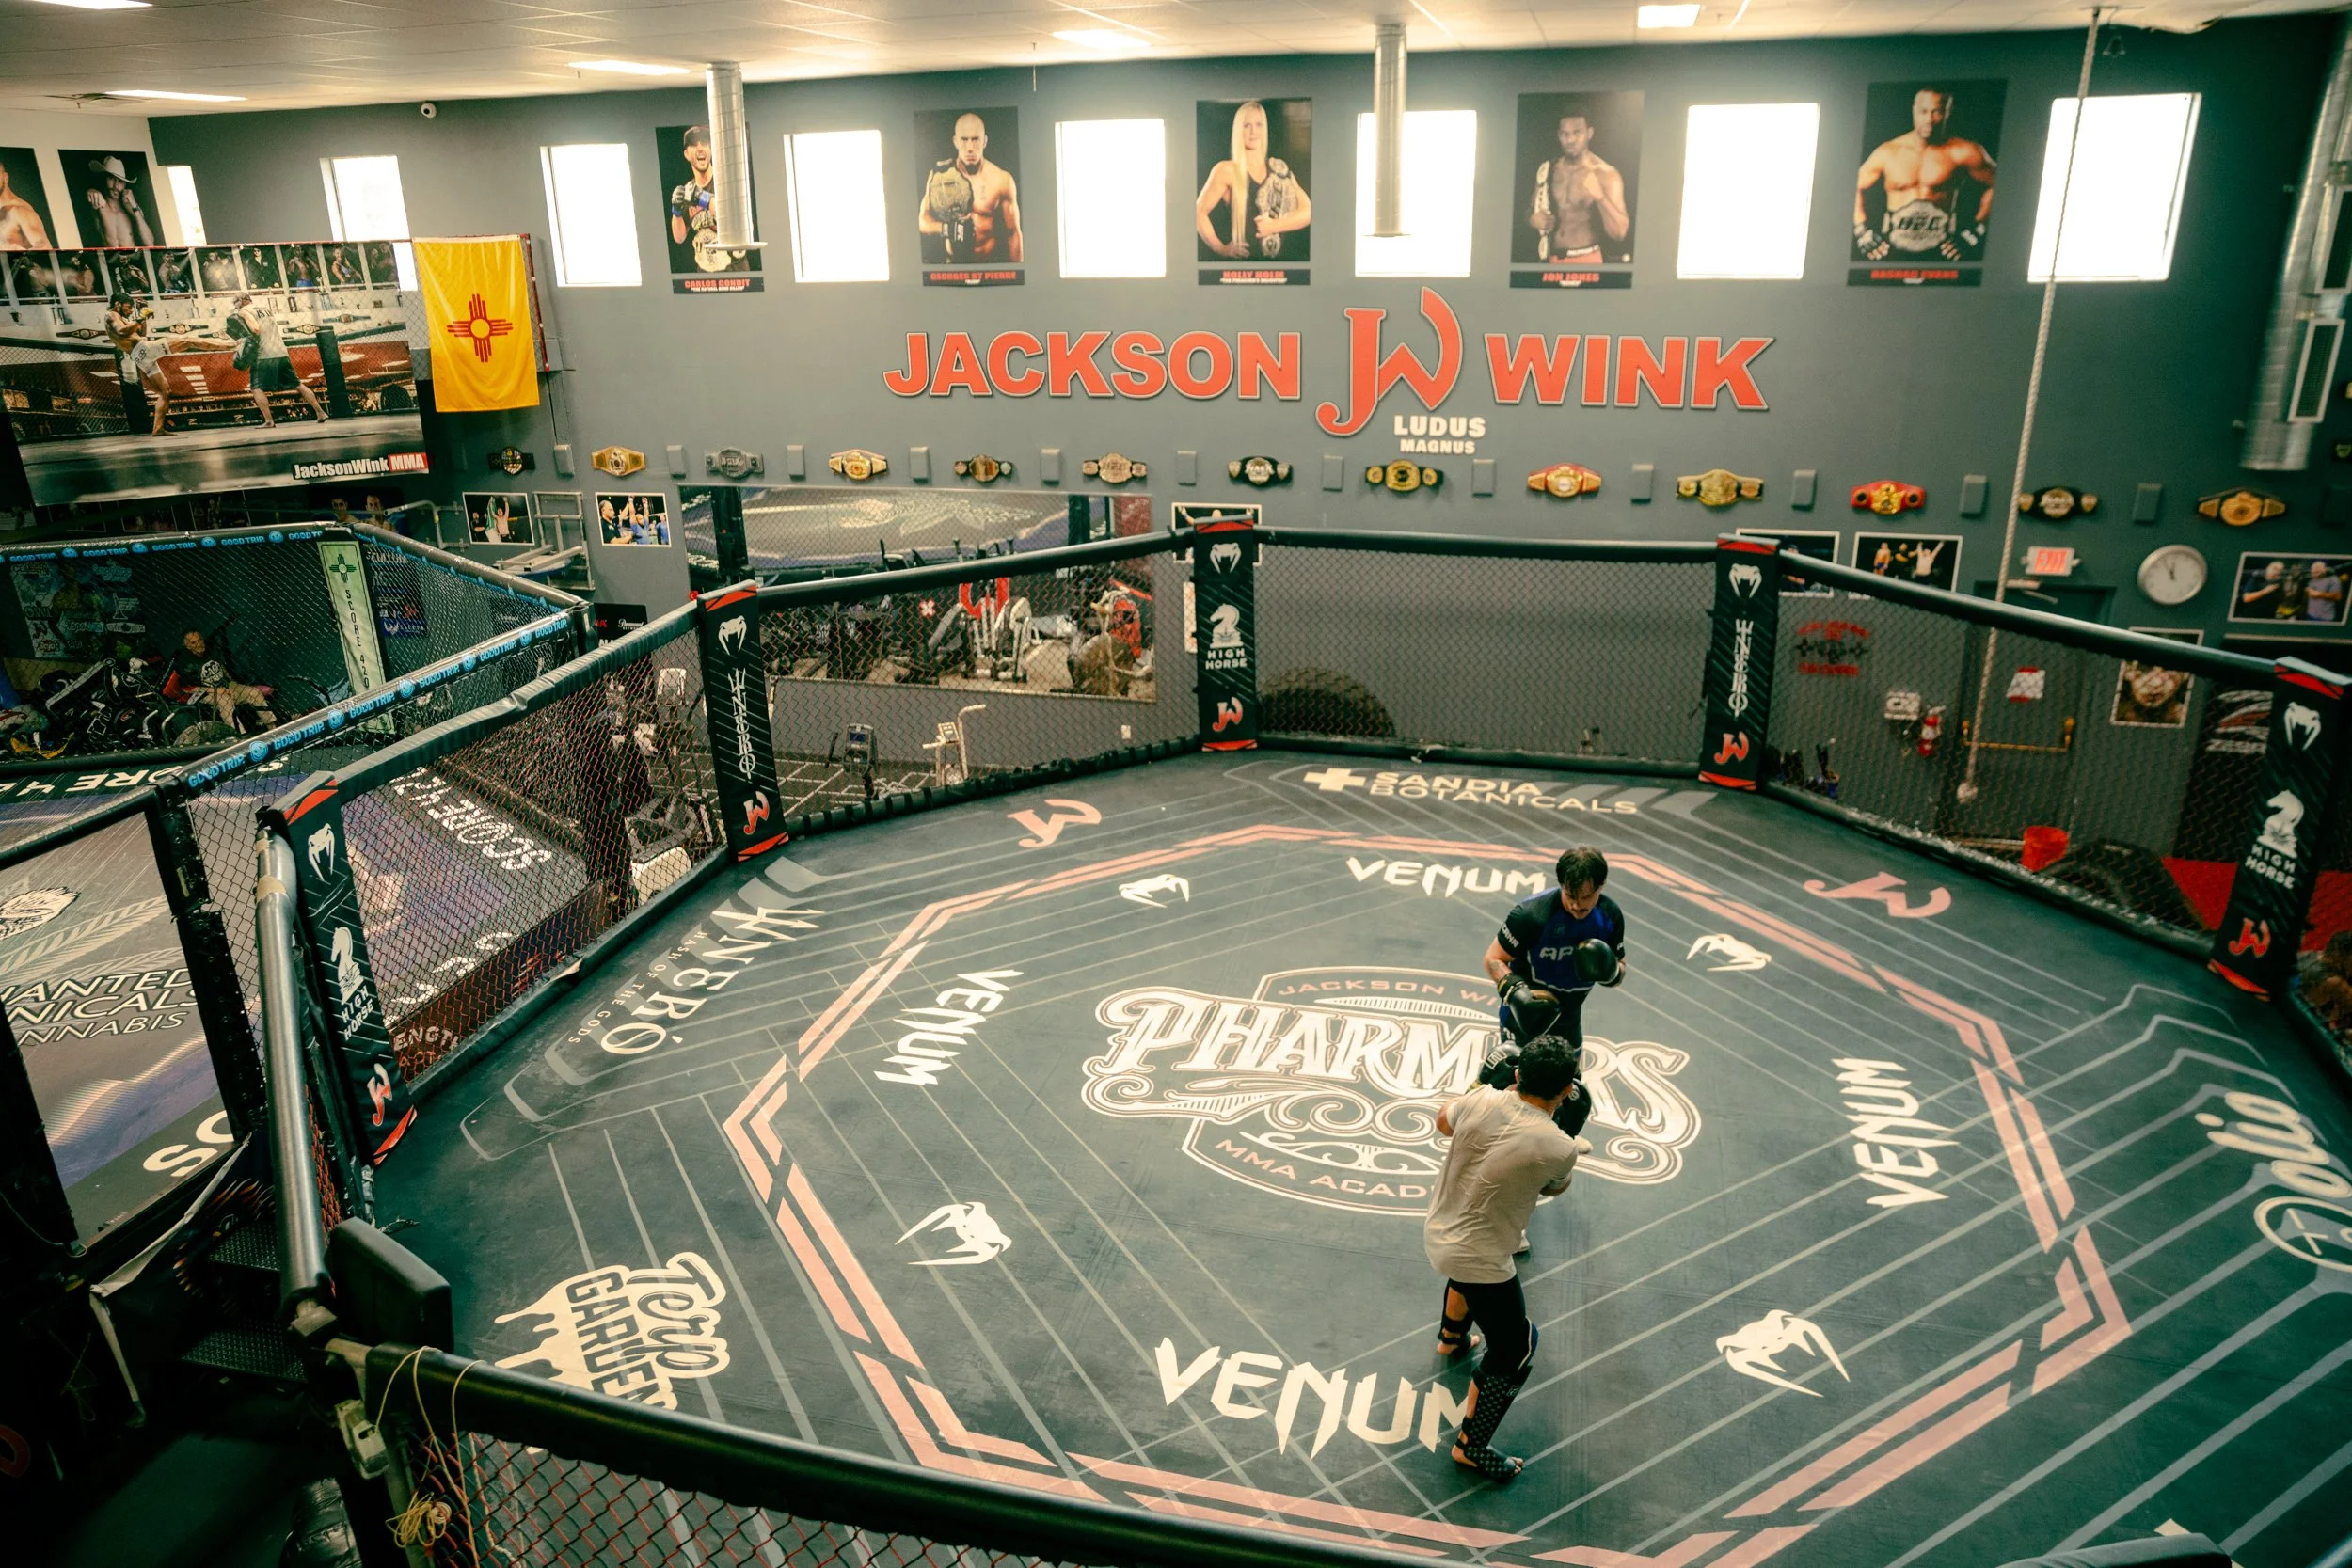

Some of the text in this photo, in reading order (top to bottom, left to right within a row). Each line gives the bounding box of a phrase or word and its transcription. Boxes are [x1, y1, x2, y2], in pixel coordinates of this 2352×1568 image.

[685, 278, 750, 288] CARLOS CONDIT
[882, 330, 1775, 411] JACKSON WINK
[1392, 414, 1486, 439] LUDUS
[1400, 438, 1475, 455] MAGNUS
[294, 453, 425, 479] JacksonWink MMA
[2034, 548, 2068, 573] EXIT
[345, 589, 371, 689] SCORE 420
[535, 625, 553, 639] GOOD
[480, 646, 501, 661] GOOD
[1205, 657, 1248, 670] HORSE
[1207, 648, 1245, 659] HIGH
[419, 673, 442, 689] GOOD
[349, 701, 373, 719] GOOD
[274, 733, 302, 751] GOOD
[188, 764, 219, 788] GOOD
[1370, 771, 1543, 796] SANDIA
[1369, 783, 1638, 815] BOTANICALS
[2251, 844, 2296, 874] HIGH
[1346, 857, 1546, 897] VENUM
[2245, 855, 2296, 889] HORSE
[568, 930, 708, 1043] HASH OF THE GODS
[1279, 980, 1445, 996] JACKSON
[342, 986, 369, 1023] HIGH
[344, 998, 374, 1041] HORSE
[874, 970, 1025, 1085] VENUM
[1096, 992, 1696, 1145] PHARMRS
[1832, 1058, 1961, 1209] VENUM
[1216, 1139, 1296, 1180] MMA
